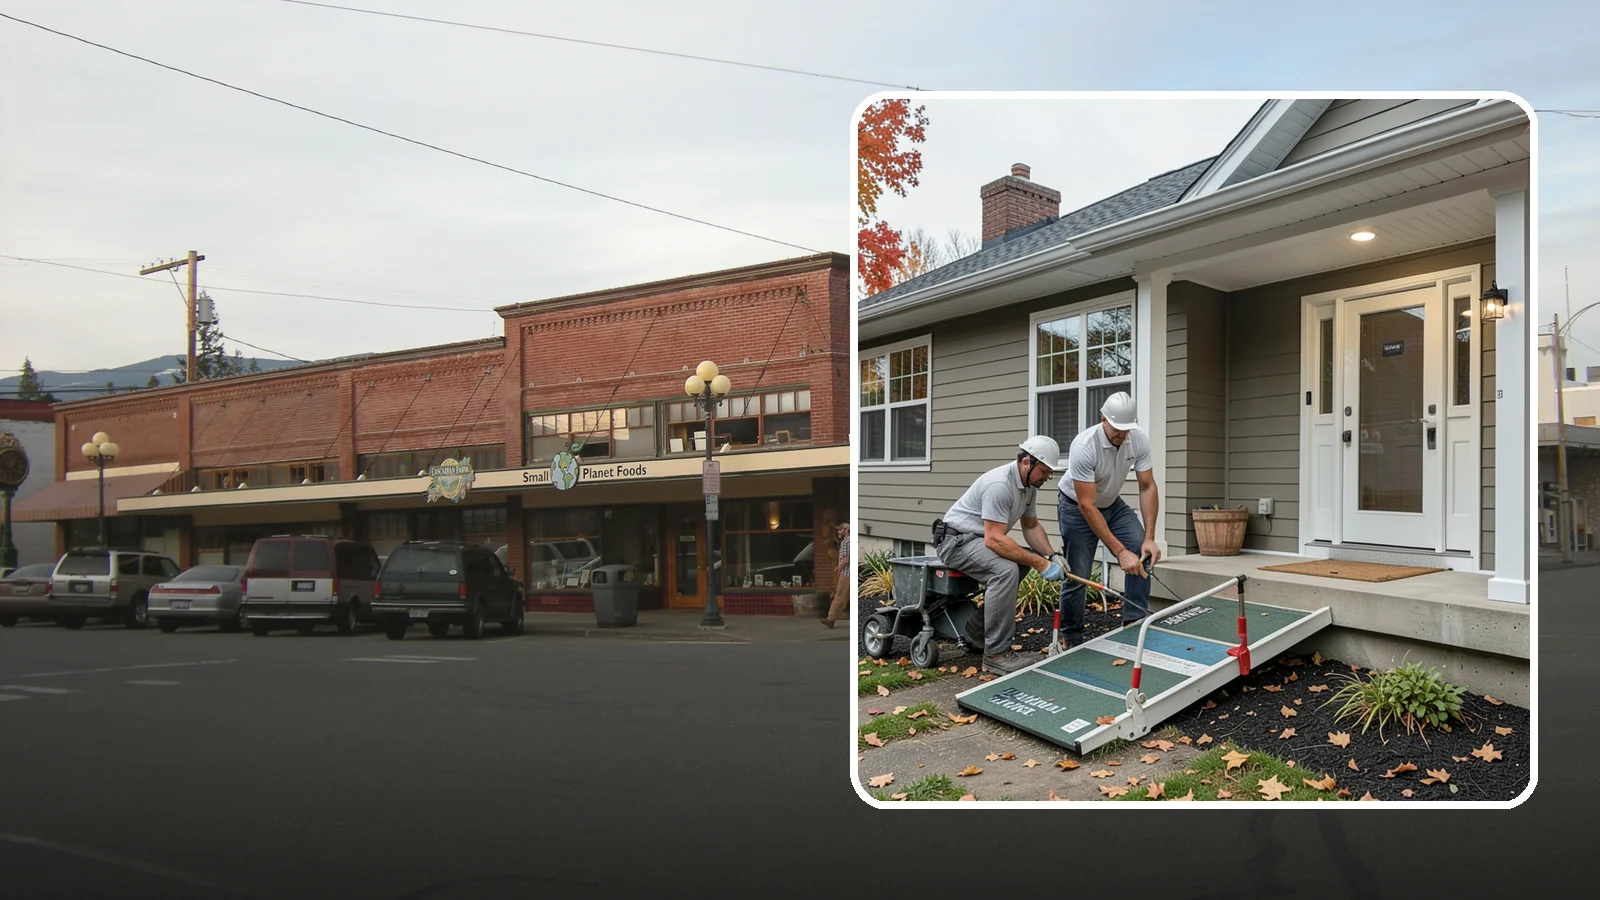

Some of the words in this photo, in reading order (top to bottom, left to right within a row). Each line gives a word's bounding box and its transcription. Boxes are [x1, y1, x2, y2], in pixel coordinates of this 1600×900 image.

[523, 471, 549, 483] Small
[583, 467, 614, 479] Planet
[617, 464, 647, 477] Foods
